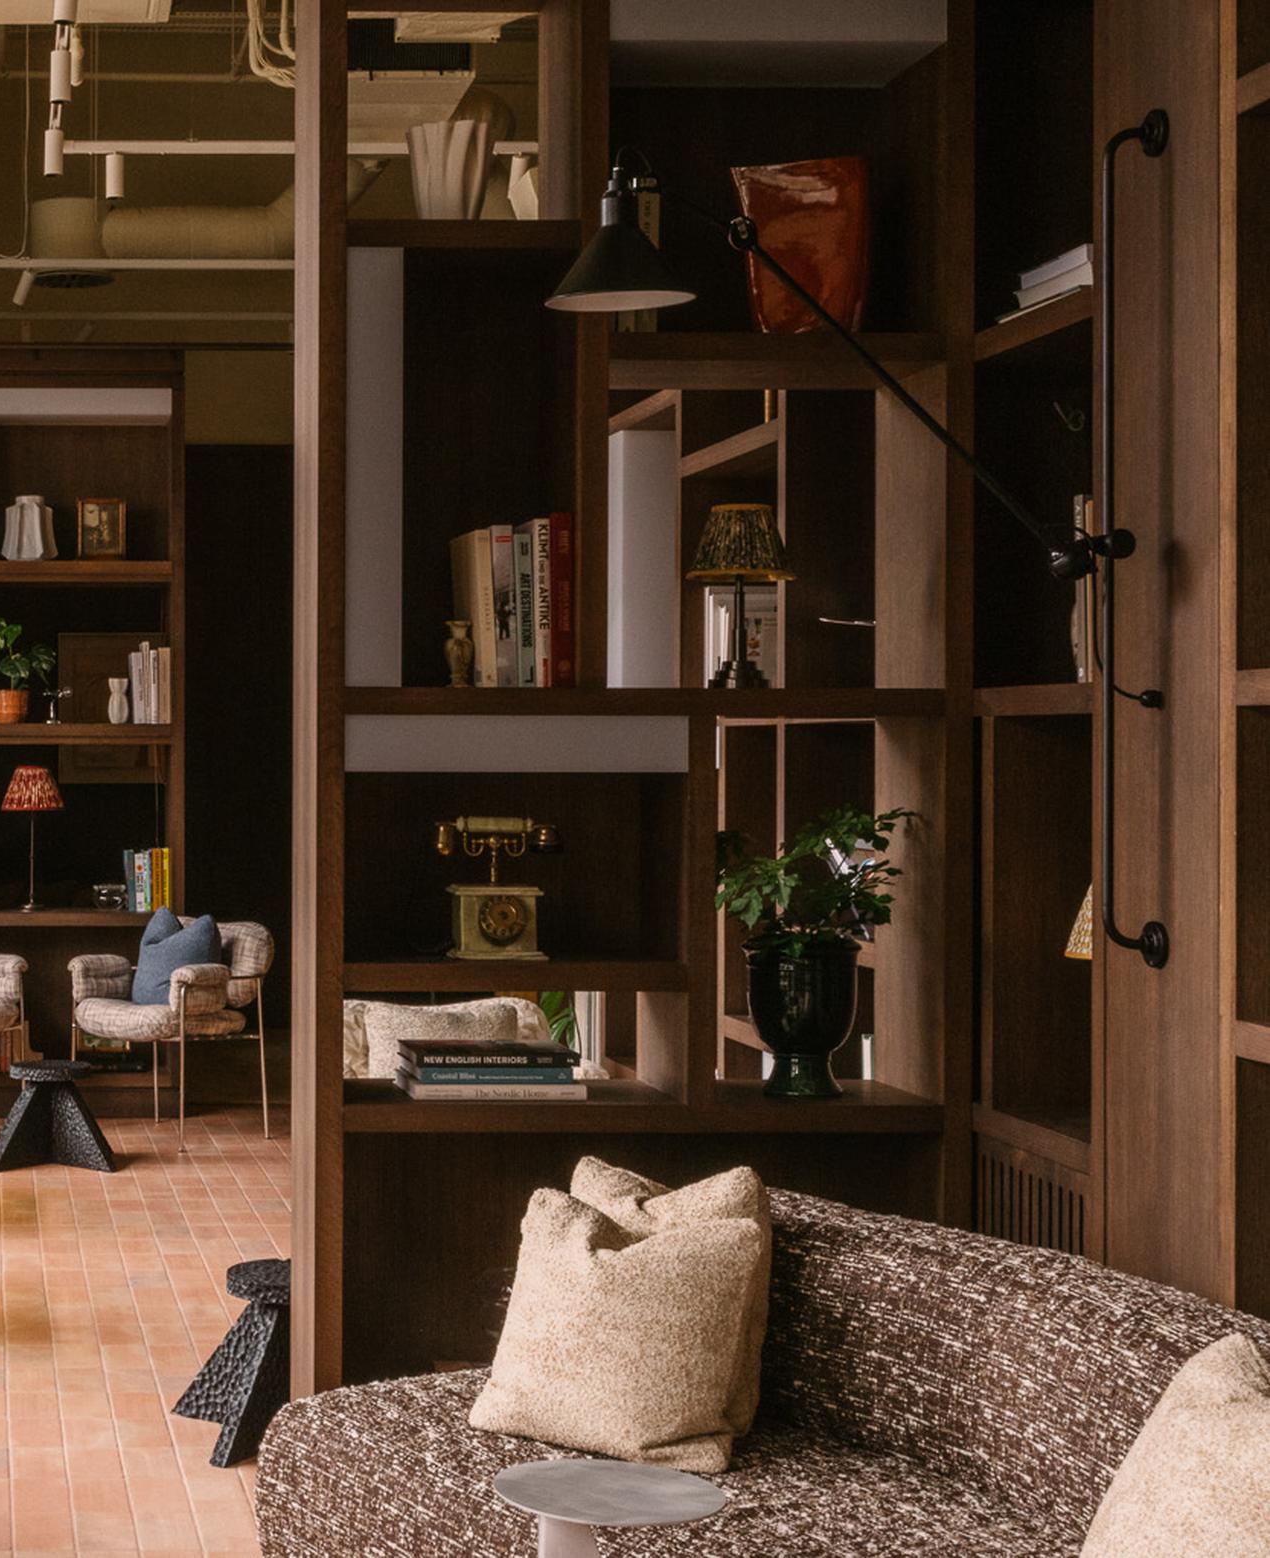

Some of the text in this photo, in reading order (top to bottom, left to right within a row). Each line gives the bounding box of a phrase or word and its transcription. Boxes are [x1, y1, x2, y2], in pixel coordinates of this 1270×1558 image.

[538, 524, 549, 559] KLIMT
[520, 573, 532, 648] ART DESTINATIONS
[539, 586, 550, 630] ANTIKE
[424, 1056, 443, 1064] NEW
[445, 1056, 481, 1064] ENGLISH
[483, 1056, 528, 1064] INTERIORS
[474, 1088, 490, 1098] The
